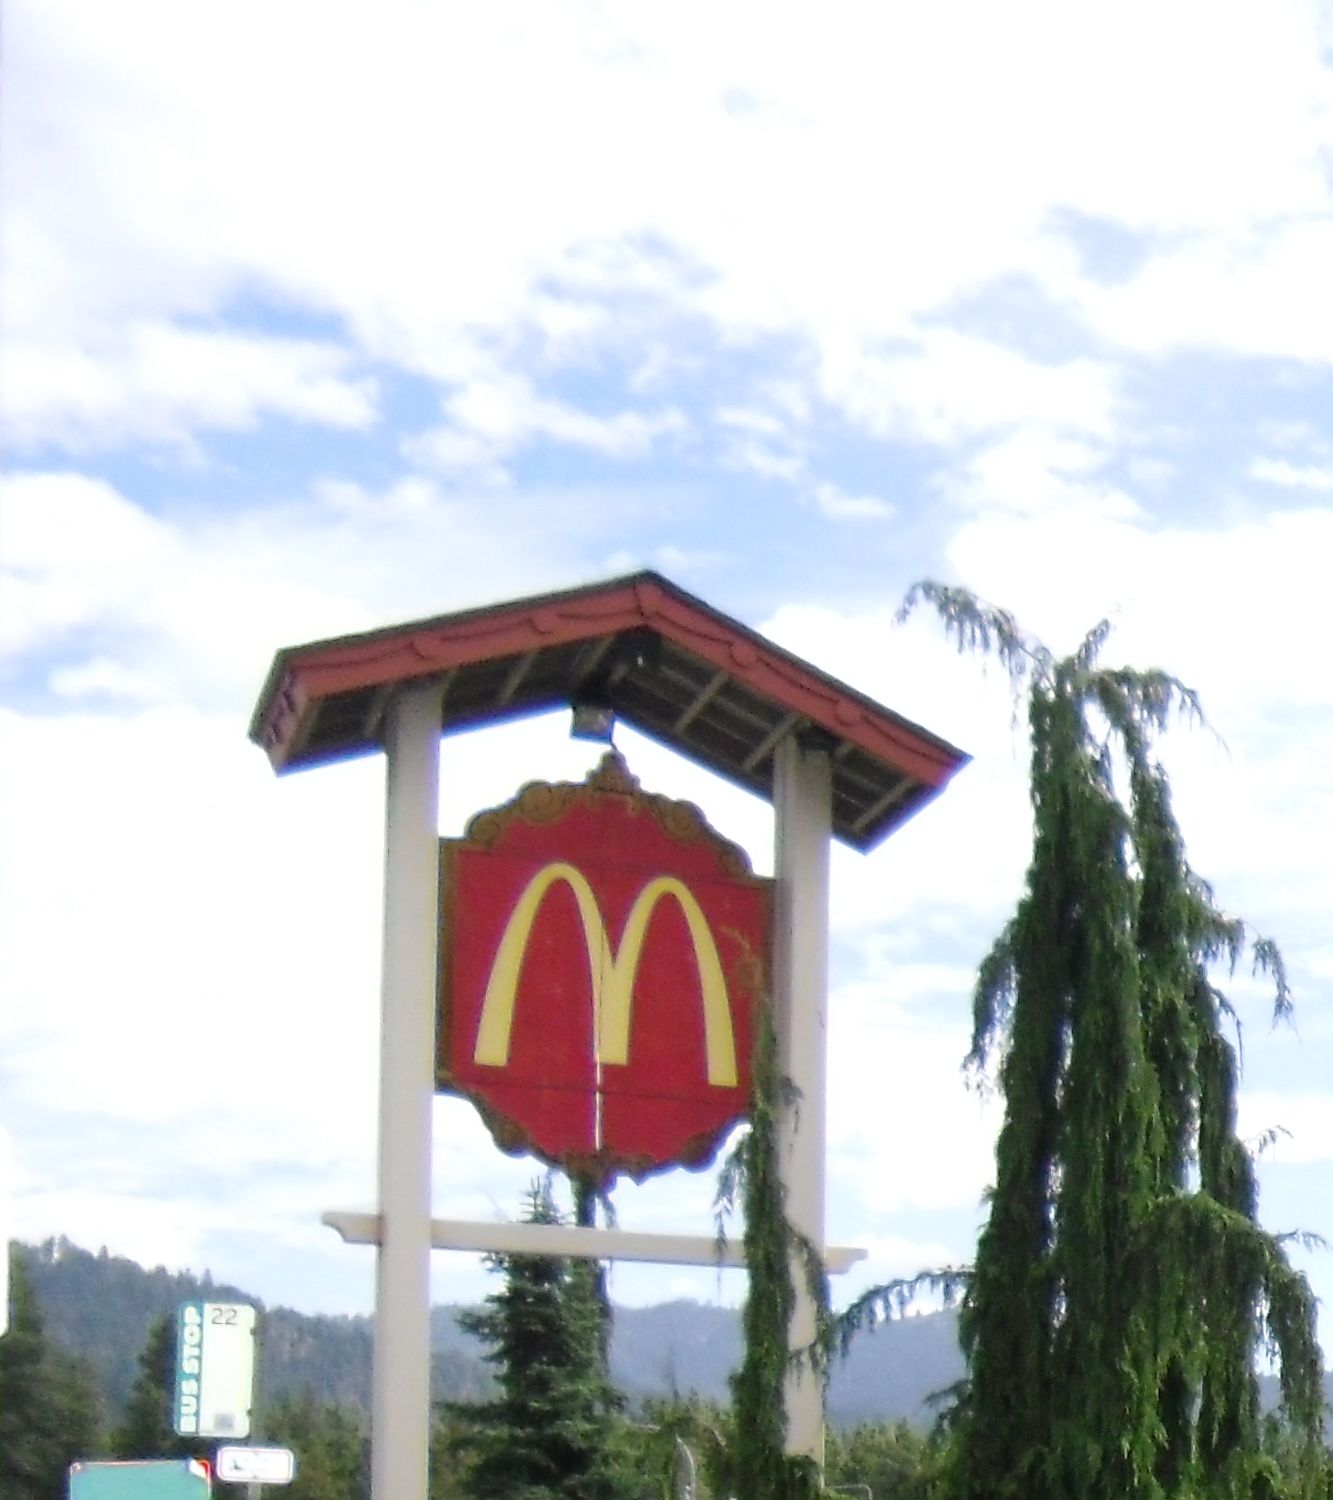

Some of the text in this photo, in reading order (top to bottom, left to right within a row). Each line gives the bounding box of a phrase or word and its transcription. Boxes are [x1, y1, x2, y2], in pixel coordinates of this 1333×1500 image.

[211, 1307, 238, 1325] 22
[180, 1306, 200, 1432] BUS STOP
